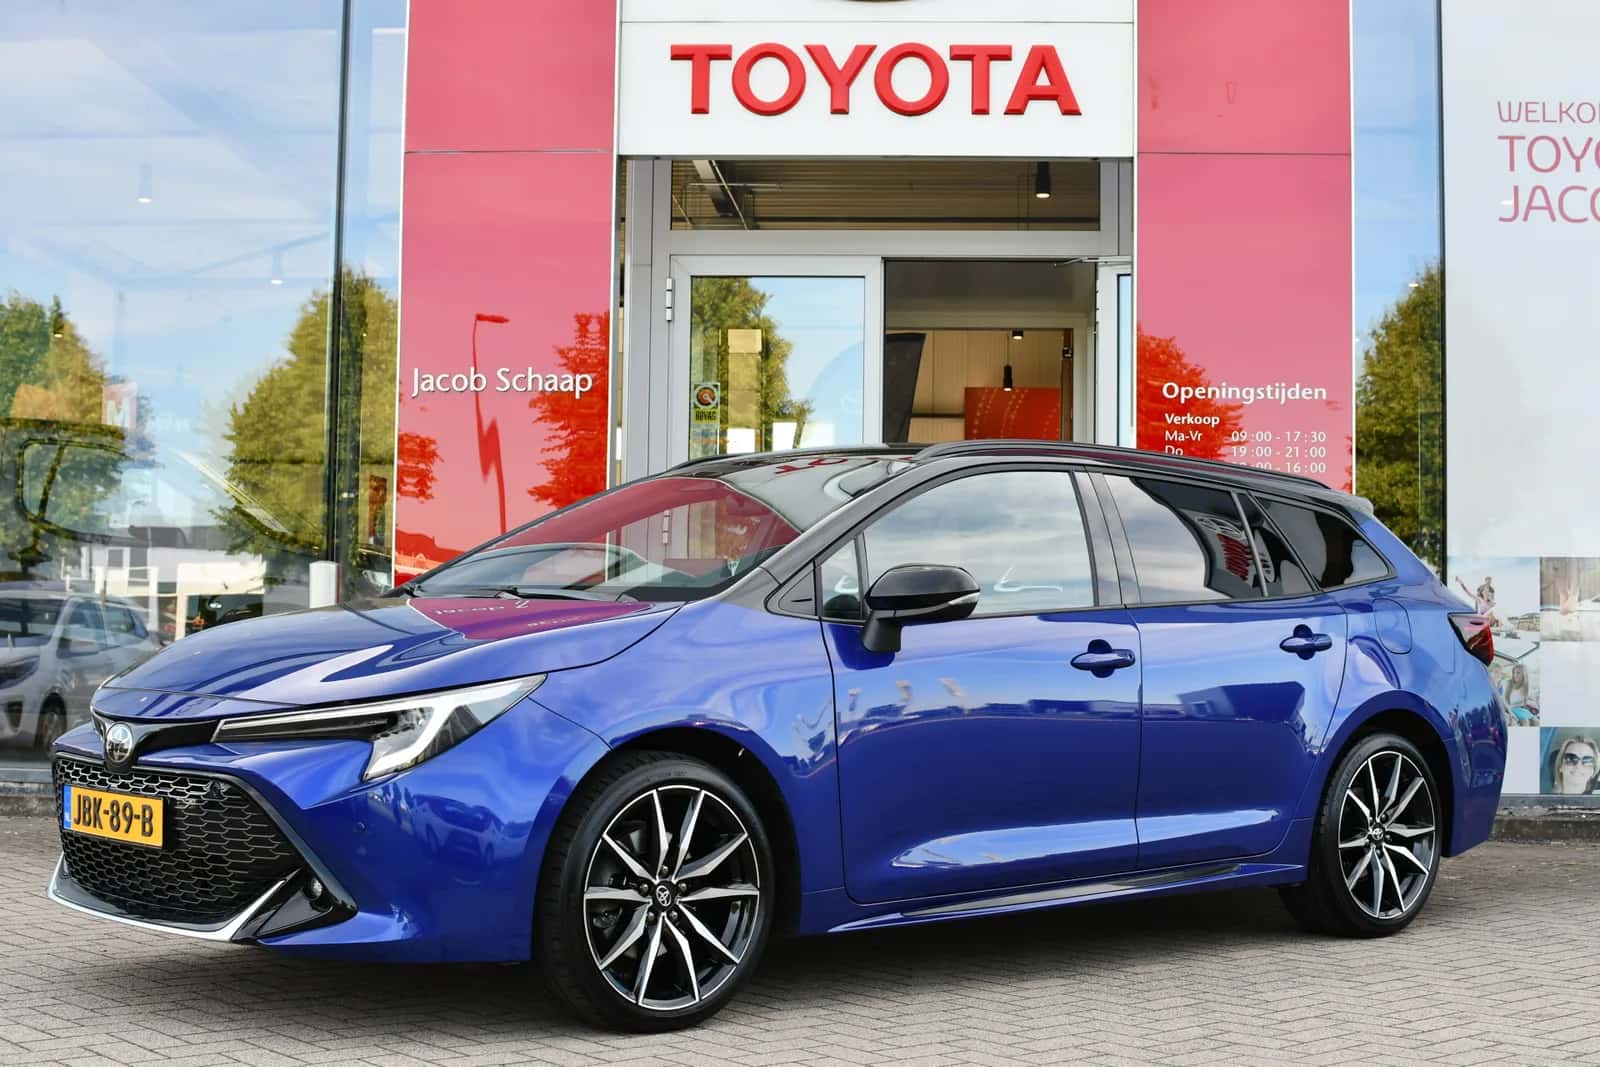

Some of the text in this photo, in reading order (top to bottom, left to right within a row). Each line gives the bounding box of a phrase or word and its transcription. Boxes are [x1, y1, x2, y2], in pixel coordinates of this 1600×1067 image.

[670, 42, 1082, 116] TOYOTA
[1497, 101, 1600, 124] WELKO
[1497, 135, 1600, 173] TOY
[412, 367, 593, 400] Jacob Schaap
[1162, 382, 1327, 404] Openingstijden
[1164, 412, 1220, 428] Verkoop
[1165, 430, 1203, 442] Ma-Vr
[1165, 445, 1184, 456] Do
[73, 794, 154, 837] JBK-89-B
